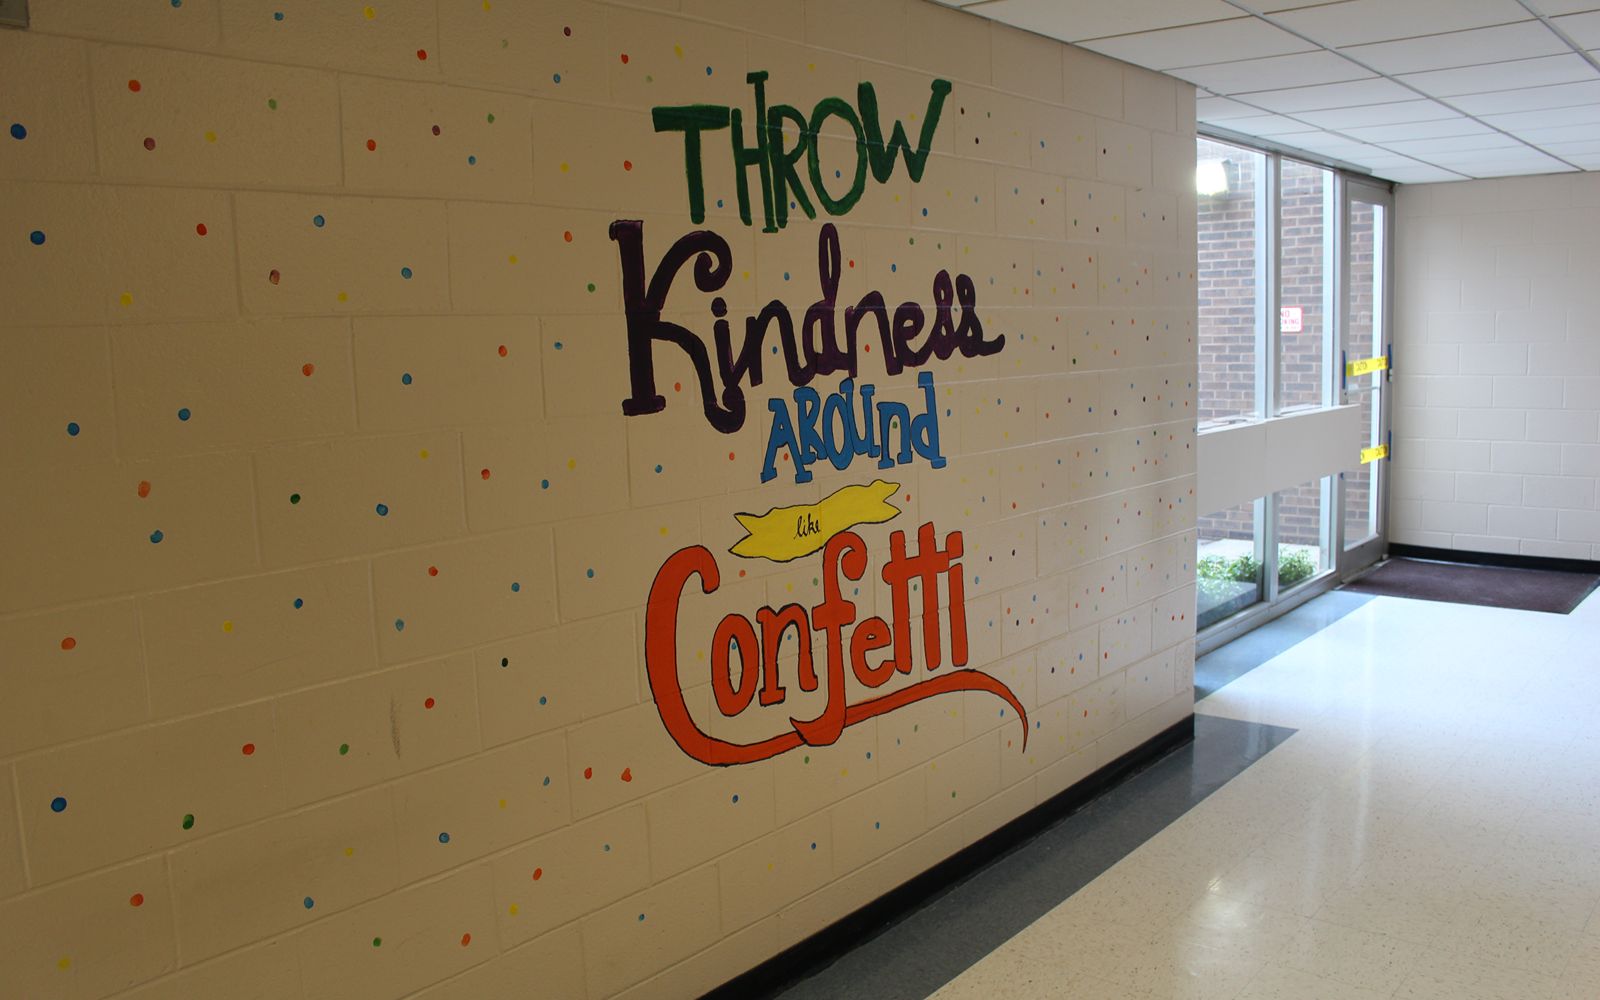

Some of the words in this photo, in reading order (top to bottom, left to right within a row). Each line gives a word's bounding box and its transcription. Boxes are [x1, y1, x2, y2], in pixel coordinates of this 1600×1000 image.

[652, 71, 952, 233] THROW
[609, 219, 1006, 434] Kindness
[793, 513, 821, 540] like
[645, 521, 1028, 767] Confetti
